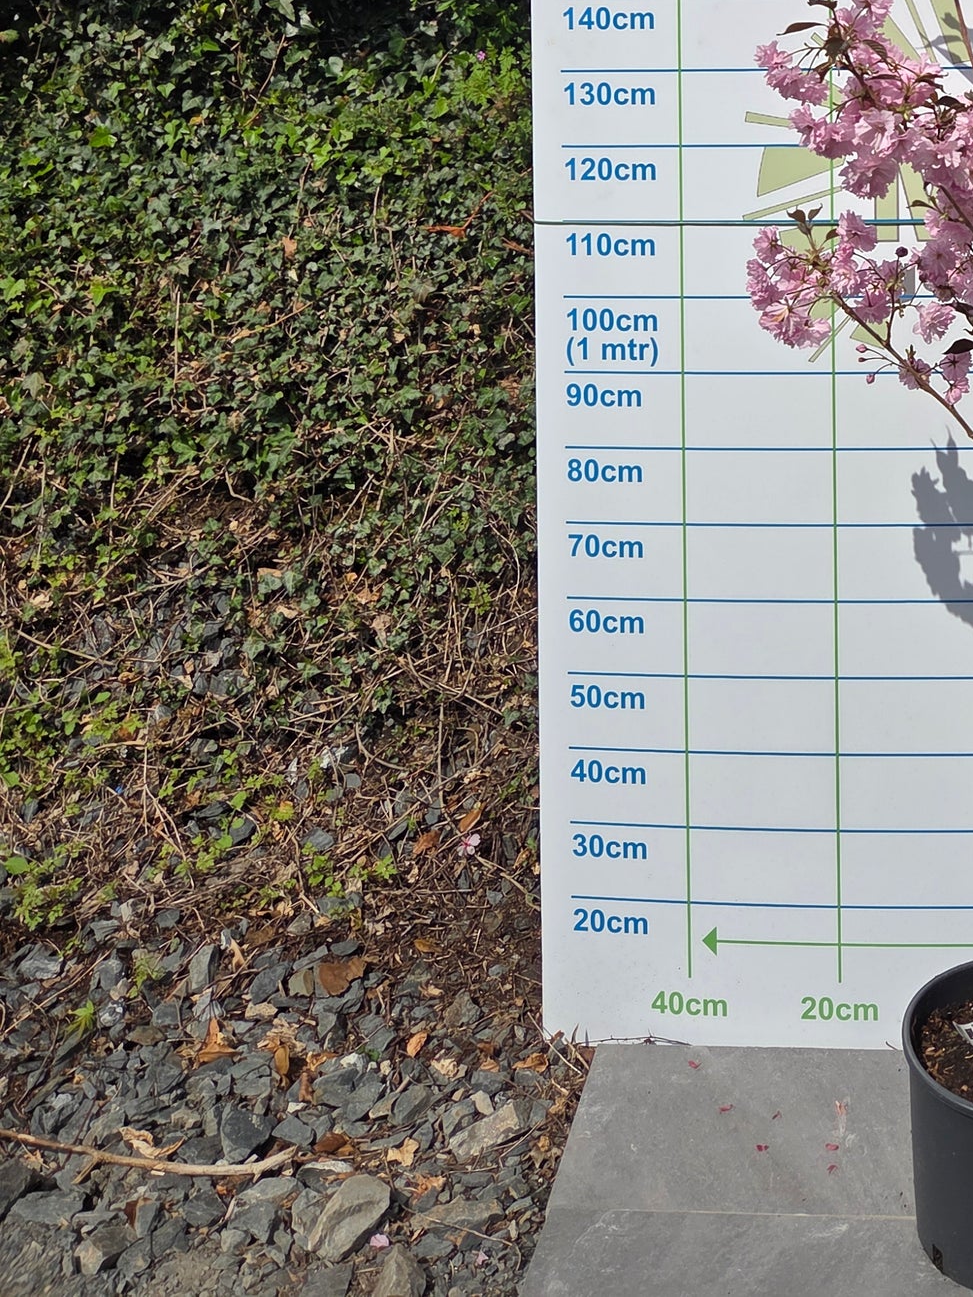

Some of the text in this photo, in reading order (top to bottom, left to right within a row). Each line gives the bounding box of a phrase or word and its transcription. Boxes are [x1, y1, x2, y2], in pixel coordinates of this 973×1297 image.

[563, 7, 655, 29] 140cm
[564, 83, 656, 105] 130cm
[565, 158, 657, 180] 120cm
[566, 233, 655, 256] 110cm
[567, 308, 658, 332] 100cm
[566, 337, 659, 366] (1 mtr)
[566, 384, 642, 407] 90cm
[567, 459, 643, 482] 80cm
[568, 535, 644, 558] 70cm
[569, 610, 644, 633] 60cm
[571, 685, 645, 709] 50cm
[571, 760, 646, 784] 40cm
[572, 834, 647, 859] 30cm
[573, 909, 648, 934] 20cm
[651, 991, 727, 1017] 40cm
[800, 996, 878, 1021] 20cm
